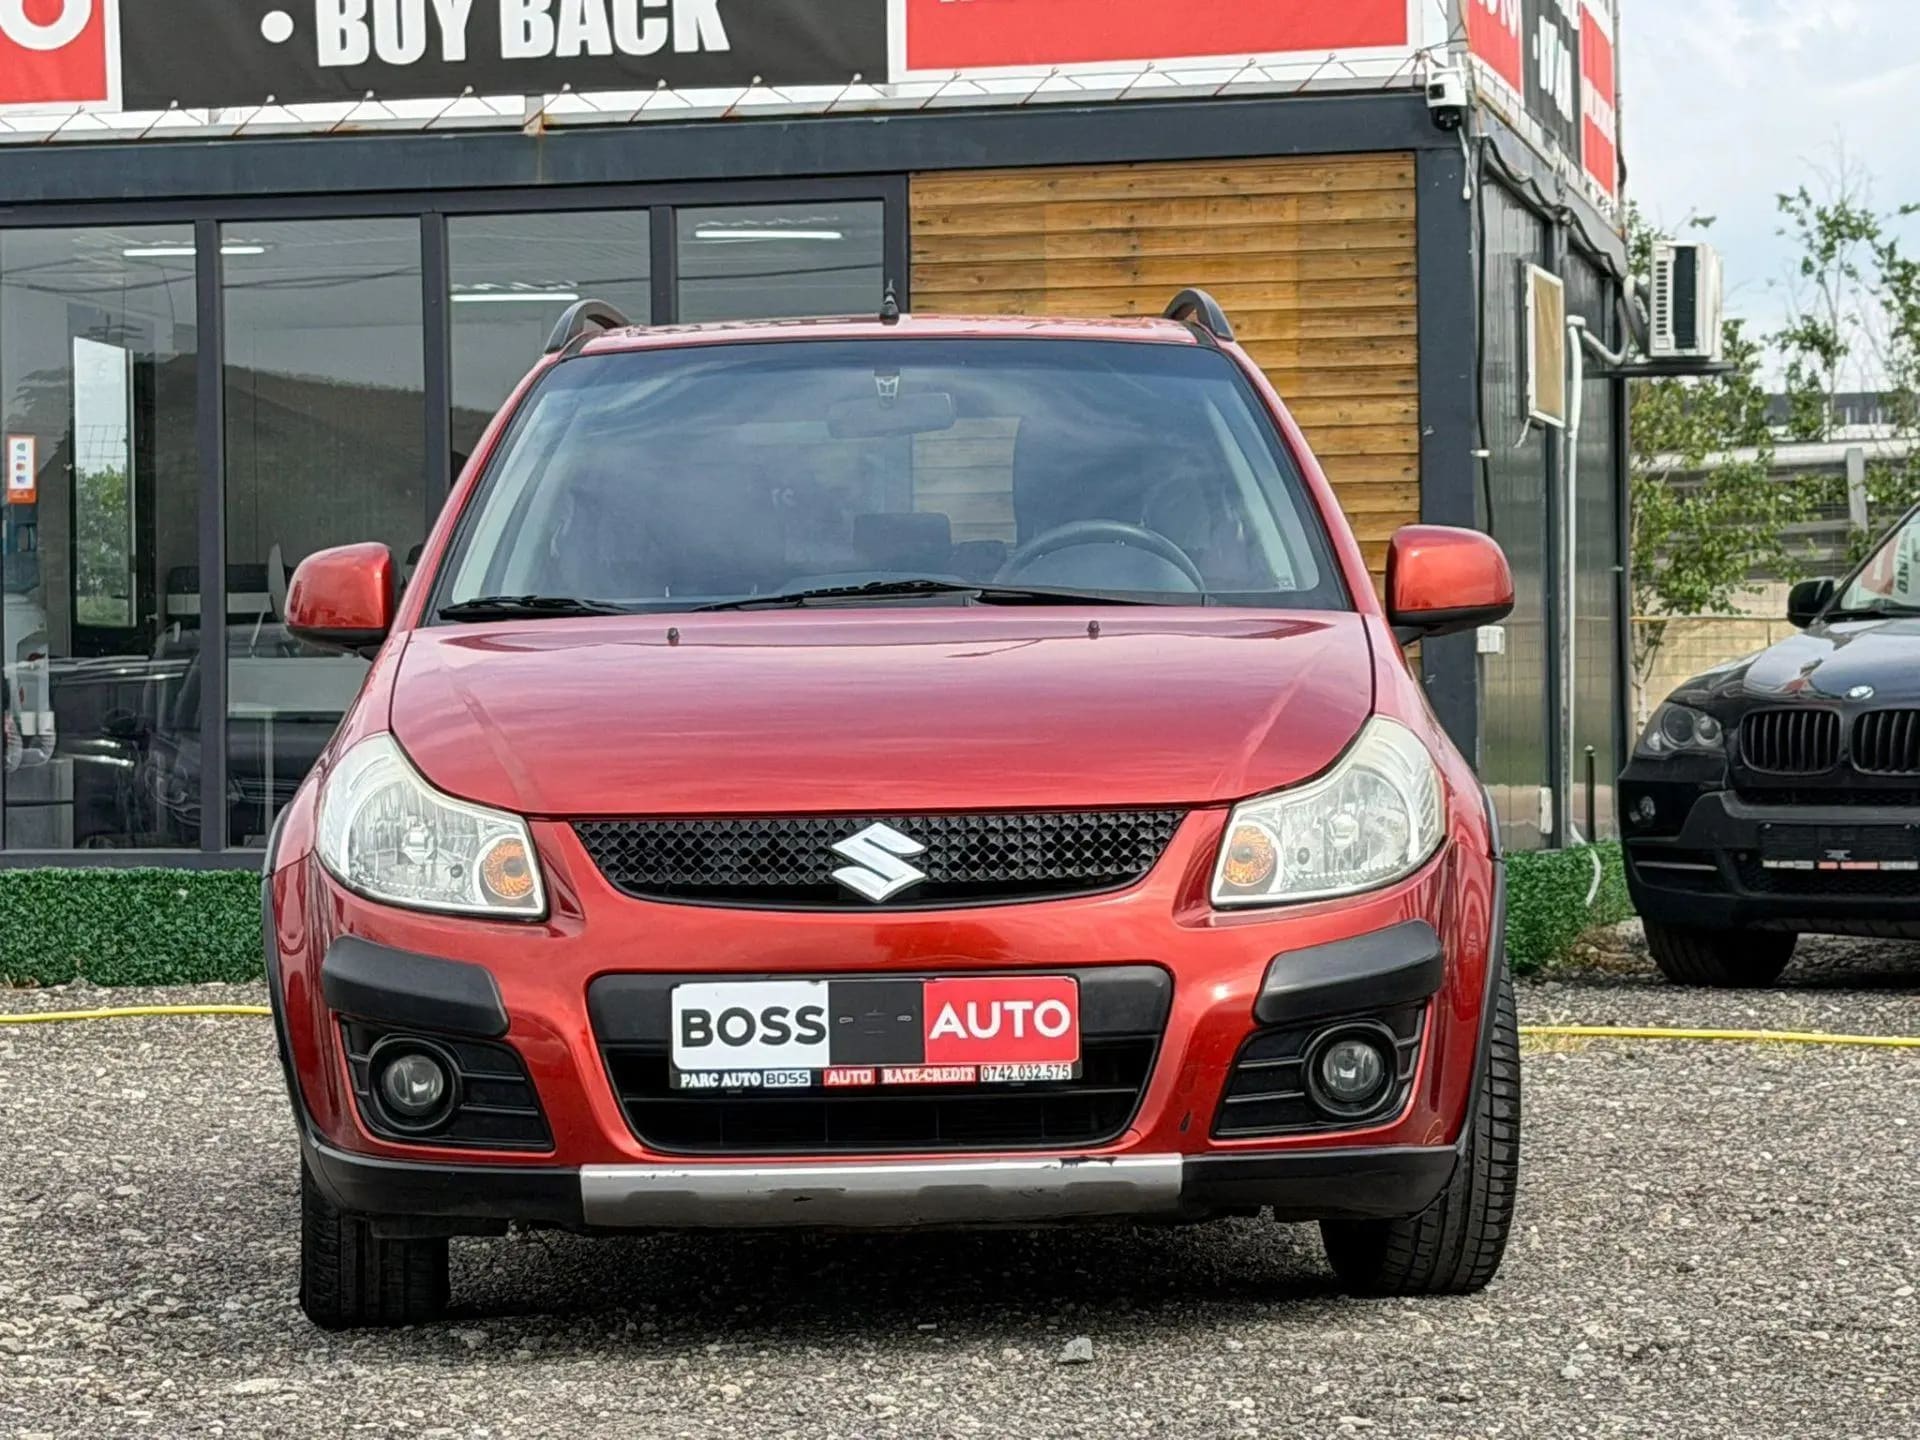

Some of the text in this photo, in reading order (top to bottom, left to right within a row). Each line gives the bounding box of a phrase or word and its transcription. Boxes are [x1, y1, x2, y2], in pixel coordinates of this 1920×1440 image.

[313, 0, 730, 66] BUY BACK
[681, 1005, 827, 1048] BOSS
[928, 1000, 1071, 1041] AUTO
[680, 1072, 719, 1088] PARC
[720, 1071, 761, 1088] AUTO
[765, 1071, 809, 1085] BOSS
[828, 1069, 872, 1085] AUTO
[982, 1064, 1070, 1081] 0742.032.575
